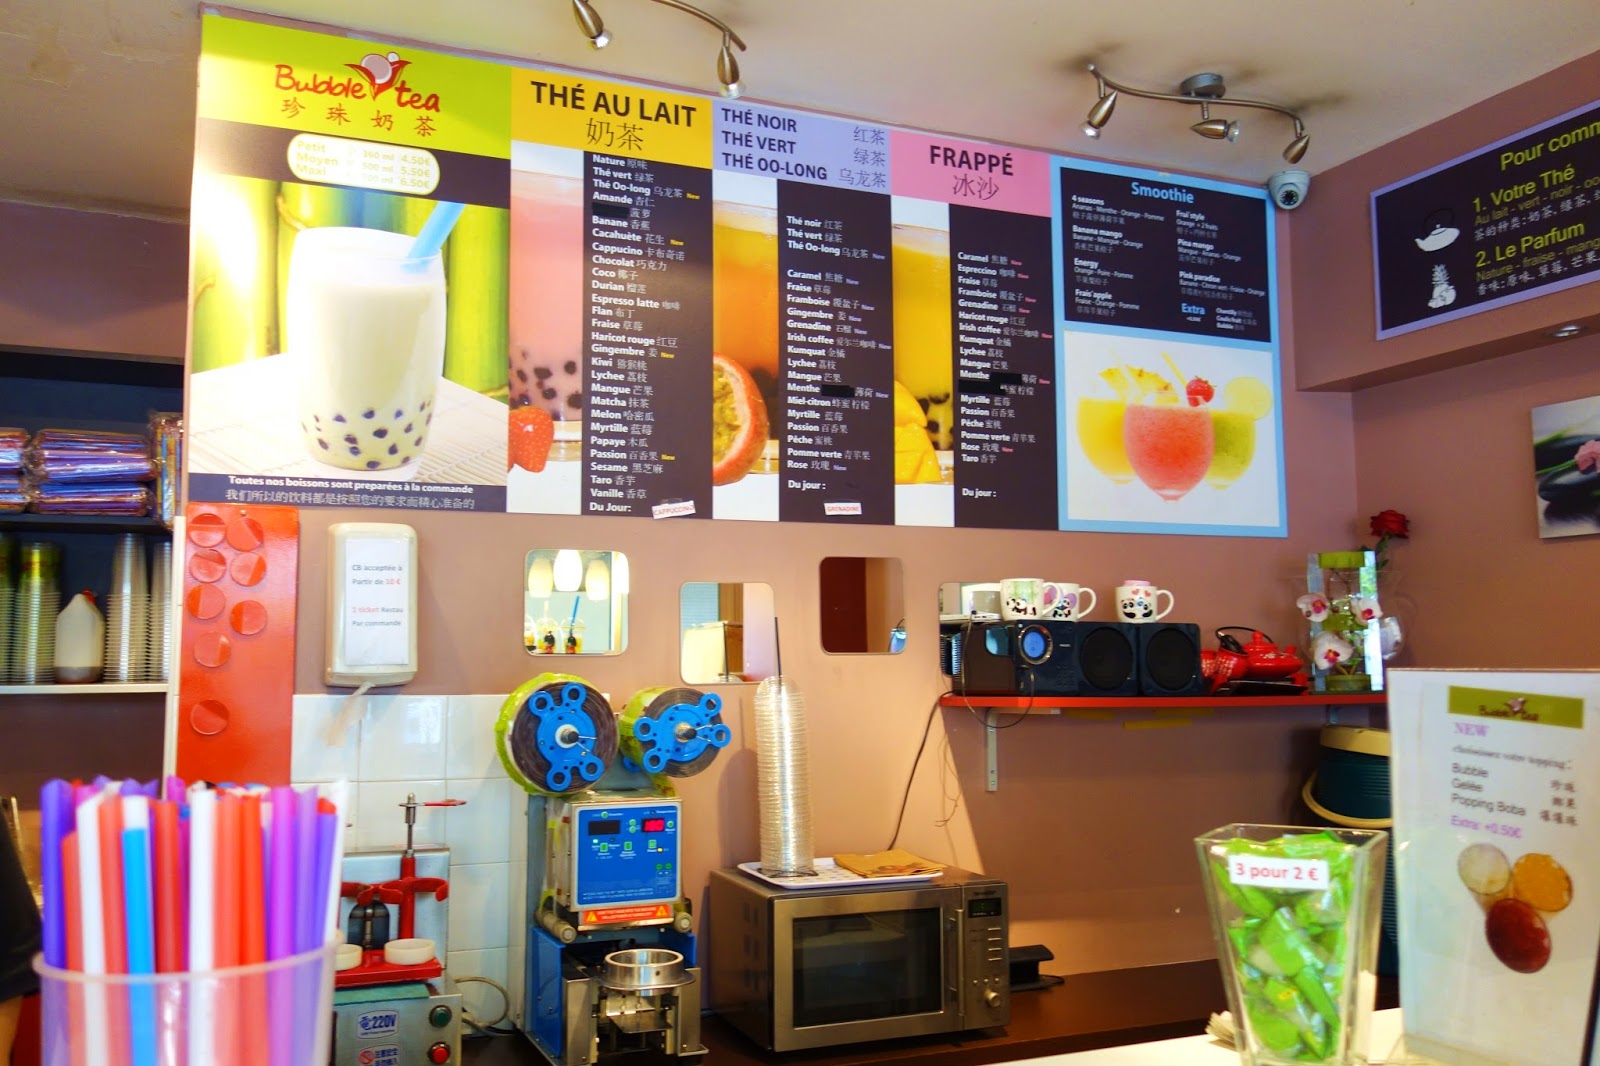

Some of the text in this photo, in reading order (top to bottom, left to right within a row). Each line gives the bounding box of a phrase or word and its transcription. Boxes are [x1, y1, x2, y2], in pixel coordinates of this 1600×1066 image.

[275, 64, 441, 112] Bubble tea
[530, 80, 696, 128] THÉ AU LAIT
[281, 97, 437, 138] 珍珠奶茶
[721, 108, 885, 146] THÉ NOIR 红茶
[586, 118, 644, 150] 奶茶
[297, 140, 431, 166] Petit 4.50€
[722, 130, 886, 167] THÉ VERT 绿茶
[593, 154, 626, 167] Nature
[930, 144, 1014, 176] FRAPPÉ
[1500, 142, 1544, 170] Pour
[296, 152, 430, 178] Moyen 5.50€
[722, 152, 886, 188] THÉ OO-LONG 乌龙茶
[296, 164, 430, 188] Maxi 6.50€
[593, 167, 632, 180] Thé vert
[593, 179, 683, 199] Thé Oo-long 乌龙茶
[952, 173, 1000, 200] 冰沙
[1473, 163, 1576, 213] 1. Votre Thé
[593, 192, 633, 205] Amande
[1131, 182, 1194, 204] Smoothie
[1072, 194, 1104, 206] 4 seasons
[1474, 184, 1574, 226] Au lait vert noir
[592, 216, 628, 228] Banane
[592, 228, 665, 246] Cacahuète 花生
[1072, 225, 1123, 239] Banana mango
[592, 242, 643, 256] Cappucino
[1192, 242, 1214, 250] mango
[1476, 223, 1585, 268] 2. Le Parfum
[592, 255, 667, 272] Chocolat 巧克力
[958, 252, 988, 263] Caramel
[1074, 258, 1099, 269] Energy
[592, 268, 616, 278] Coco
[958, 264, 997, 276] Espreccino
[1476, 252, 1556, 282] Nature fraise
[787, 270, 822, 280] Caramel
[958, 276, 981, 286] Fraise
[592, 280, 624, 292] Durian
[787, 282, 812, 292] Fraise
[958, 287, 997, 299] Framboise
[1092, 291, 1112, 300] apple
[592, 294, 660, 308] Espresso latte
[787, 294, 830, 306] Framboise
[958, 299, 998, 310] Grenadine
[592, 306, 613, 316] Flan
[787, 308, 834, 320] Gingembre
[1181, 303, 1206, 315] Extra
[958, 312, 1008, 324] Haricot rouge
[592, 319, 620, 330] Fraise
[787, 320, 832, 332] Grenadine
[958, 323, 1002, 334] Irish coffee
[592, 332, 678, 348] Haricot rouge 红豆
[787, 332, 834, 344] Irish coffee
[959, 335, 994, 346] Kumquat
[592, 344, 645, 357] Gingembre
[787, 345, 826, 356] Kumquat
[960, 347, 986, 357] Lychee
[592, 357, 613, 368] Kiwi
[788, 358, 816, 368] Lychee
[960, 358, 991, 370] Mangue
[591, 370, 624, 382] Lychee
[788, 371, 822, 382] Mangue
[591, 384, 654, 396] Mangue 芒果
[788, 383, 820, 393] Menthe
[591, 396, 626, 407] Matcha
[788, 396, 831, 407] Miel-citron
[591, 410, 622, 420] Melon
[788, 409, 820, 420] Myrtille
[960, 407, 990, 416] Passion
[590, 423, 628, 434] Myrtille
[788, 422, 820, 432] Passion
[590, 436, 649, 448] Papaye 木瓜
[788, 434, 813, 444] Pêche
[961, 442, 980, 451] Rose
[590, 450, 658, 461] Passion 百香果
[788, 448, 820, 458] Pomme
[961, 454, 980, 463] Taro
[590, 462, 628, 472] Sesame
[788, 460, 808, 468] Rose
[229, 476, 473, 494] Toutes nos boissons sont preparées la commande
[590, 475, 636, 486] Taro 香芋
[788, 480, 821, 491] Du jour
[590, 488, 647, 500] Vanille 香草
[962, 488, 992, 499] Du jour
[590, 502, 632, 513] Du Jour:
[1454, 722, 1489, 736] NEW
[1452, 762, 1488, 778] Bubble
[1452, 792, 1526, 816] Popping Boba
[1236, 863, 1318, 881] 3 pour 2 €
[372, 1014, 398, 1030] 220V
